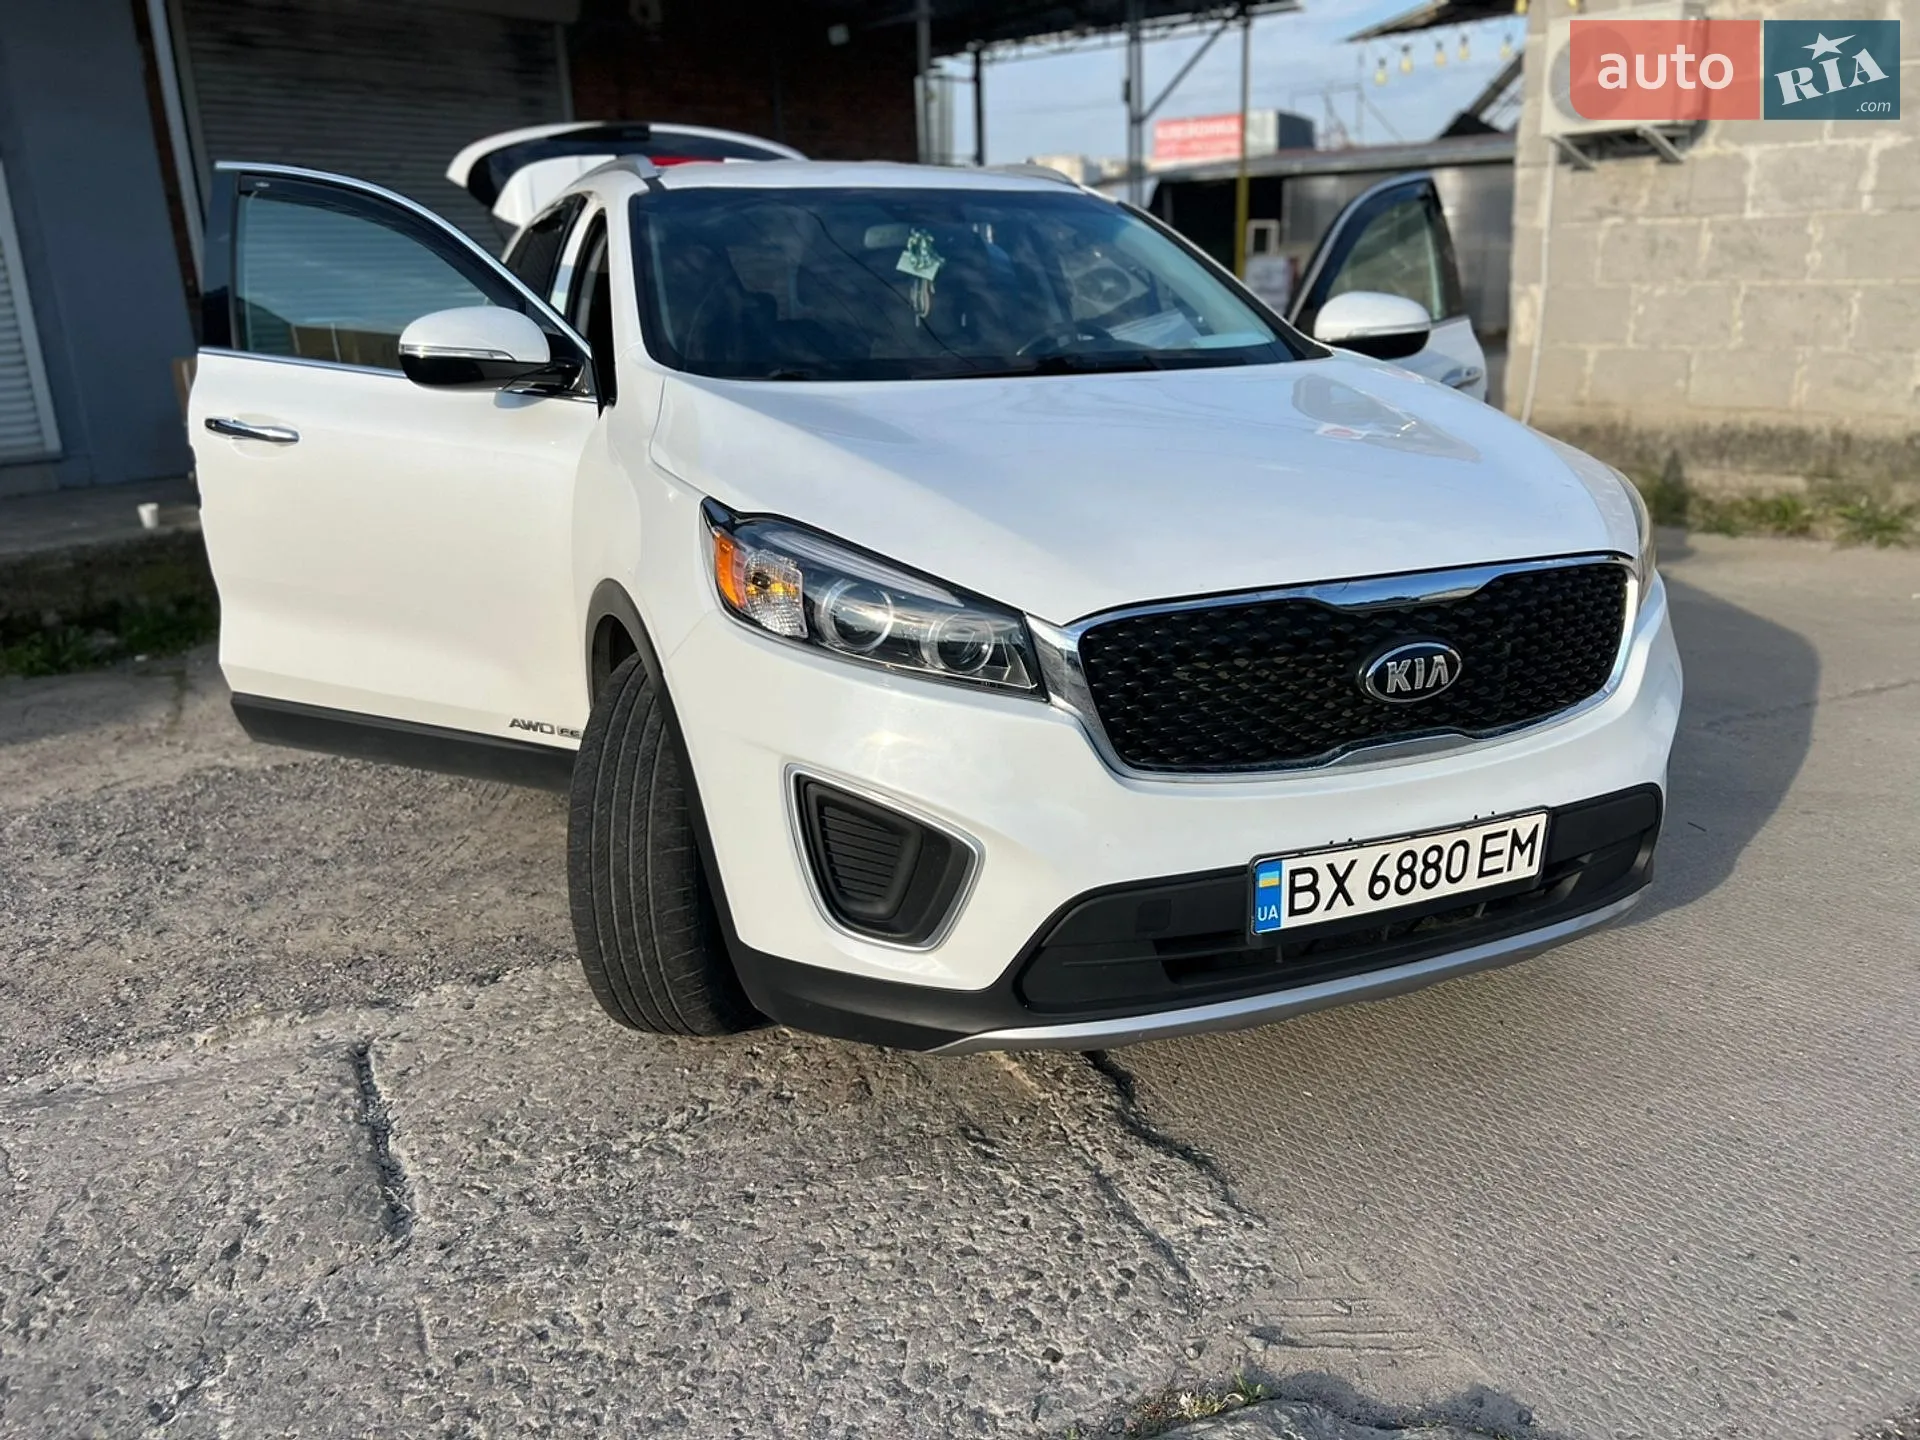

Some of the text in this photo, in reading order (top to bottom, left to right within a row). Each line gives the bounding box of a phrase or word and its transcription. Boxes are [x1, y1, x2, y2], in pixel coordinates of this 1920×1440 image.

[1386, 654, 1449, 693] KIA
[509, 718, 555, 734] AWD
[1287, 823, 1539, 917] BX 6880 EM
[1257, 904, 1279, 922] UA
